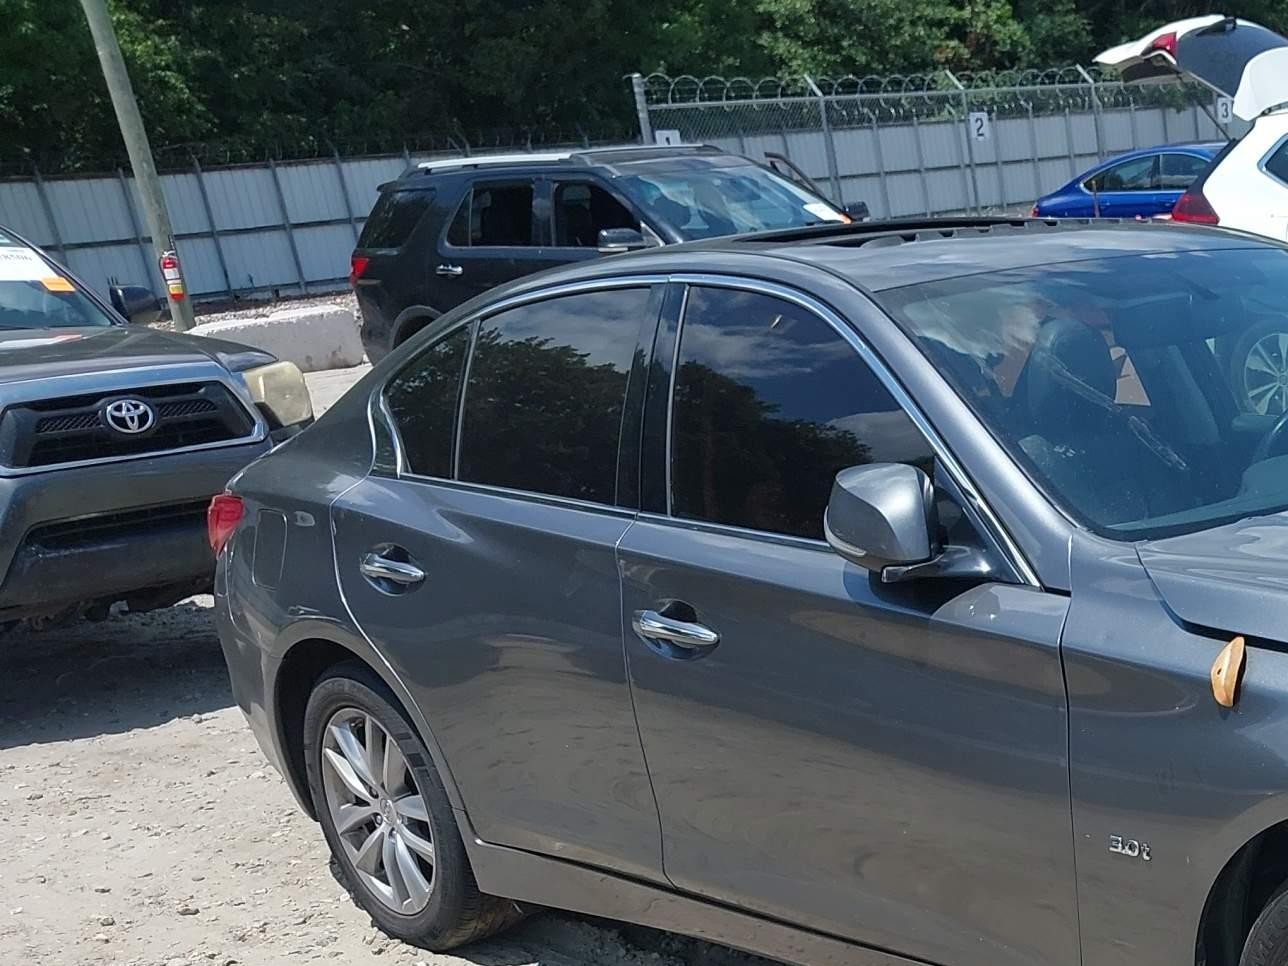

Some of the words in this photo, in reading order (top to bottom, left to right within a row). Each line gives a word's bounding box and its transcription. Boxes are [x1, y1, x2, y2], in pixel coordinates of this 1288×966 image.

[1221, 102, 1229, 119] 3
[975, 117, 984, 137] 2
[1109, 835, 1151, 861] 3.0t
